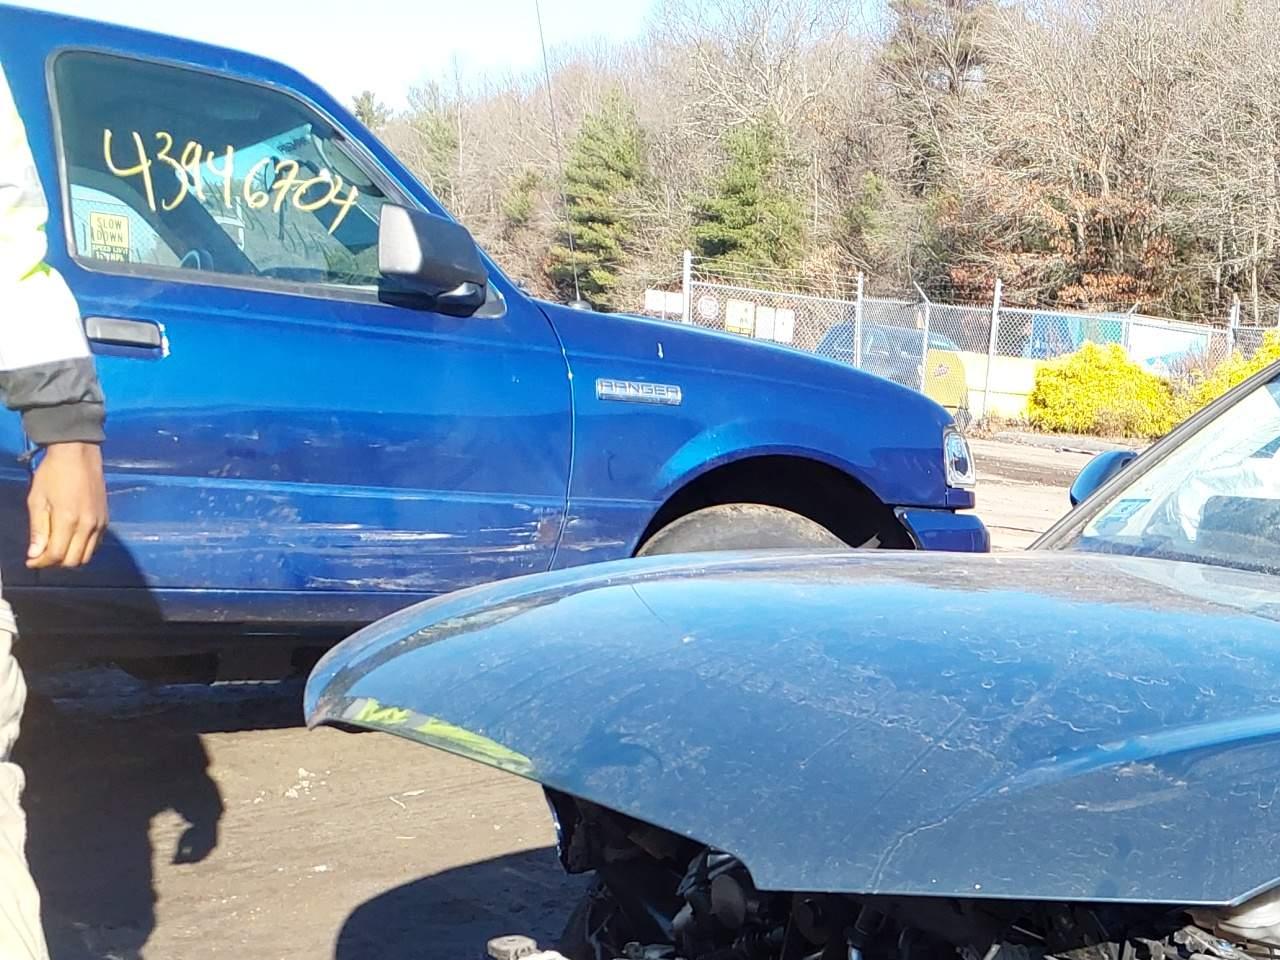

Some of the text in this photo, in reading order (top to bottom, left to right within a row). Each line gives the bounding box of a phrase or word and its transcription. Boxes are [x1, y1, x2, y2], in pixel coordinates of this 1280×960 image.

[103, 129, 358, 236] 43946704
[96, 217, 122, 230] SLOW
[96, 230, 123, 243] DOWN
[598, 380, 680, 397] RANGER
